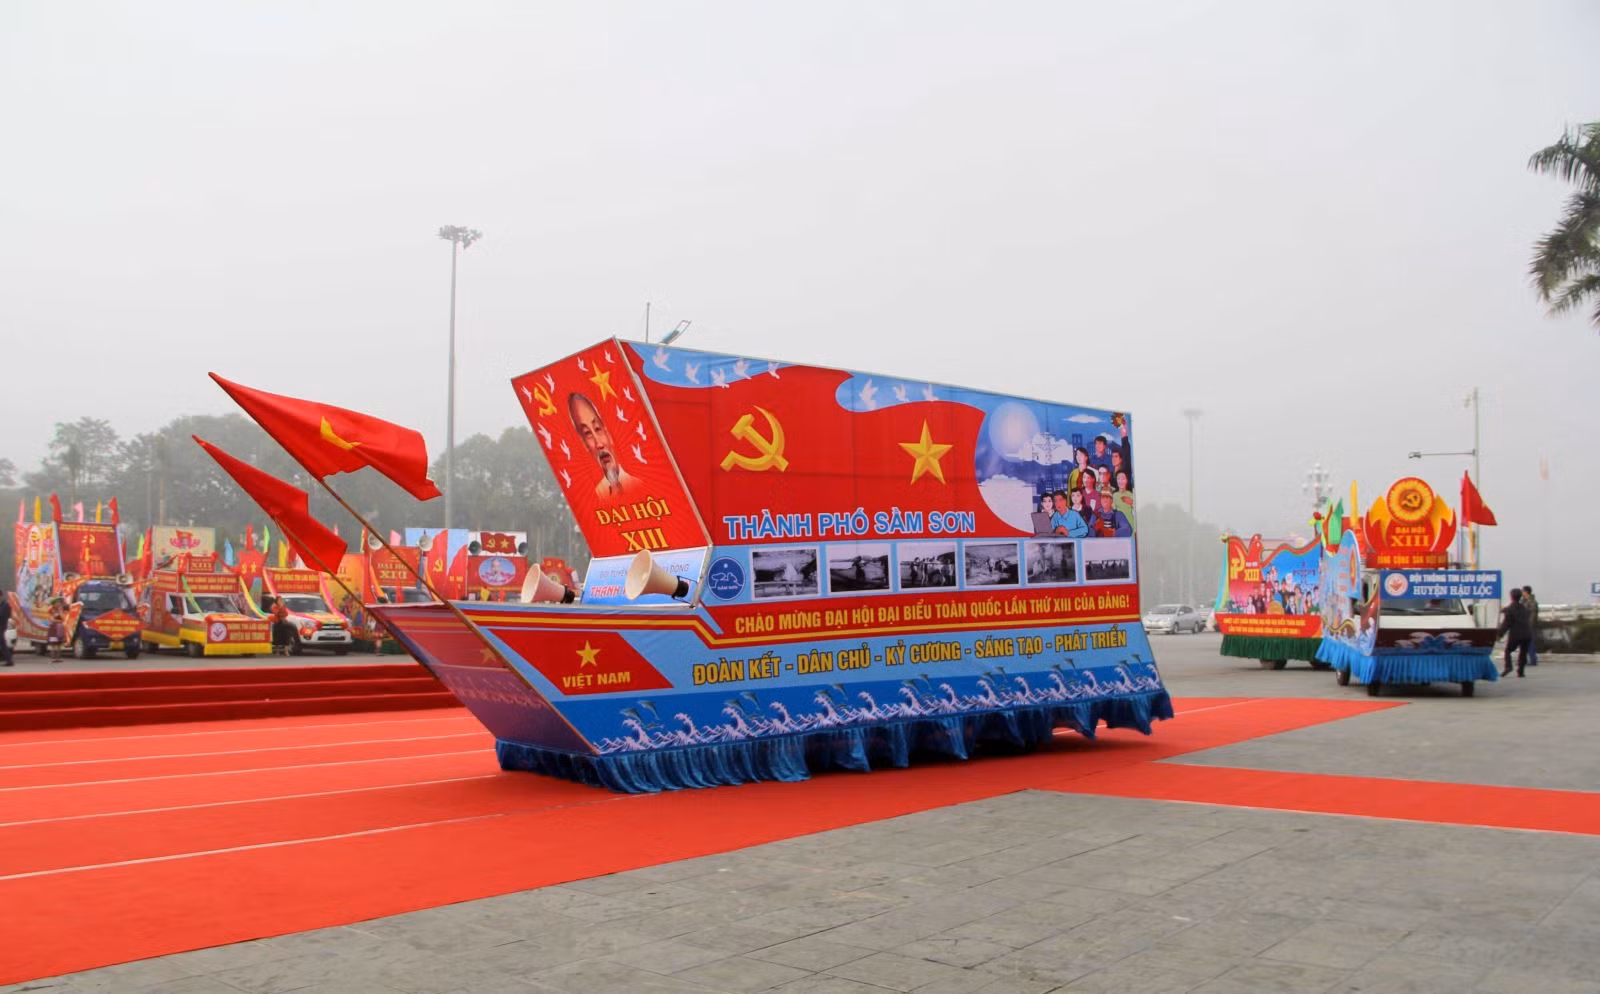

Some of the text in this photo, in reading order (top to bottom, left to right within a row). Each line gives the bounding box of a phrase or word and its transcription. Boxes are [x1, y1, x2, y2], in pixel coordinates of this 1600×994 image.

[596, 496, 672, 526] ĐẠI HỘI
[723, 506, 976, 540] THÀNH PHỐ SẦM SƠN
[621, 528, 669, 552] XIII
[1391, 535, 1429, 547] XIII
[1413, 584, 1447, 597] HUYỆN
[1472, 584, 1493, 597] LỘC
[736, 591, 1130, 634] CHÀO MỪNG ĐẠI HỘI ĐẠI BIỂU TOÀN QUỐC LẦN THỨ XIII CỦA ĐẢNG!
[692, 656, 744, 686] ĐOÀN
[748, 650, 782, 680] KẾT
[797, 648, 833, 675] DÂN
[837, 642, 871, 671] CHỦ
[885, 640, 906, 666] KỶ
[910, 640, 961, 664] CƯƠNG
[974, 635, 1014, 659] SÁNG
[1016, 635, 1043, 659] TẠO
[1055, 629, 1088, 652] PHÁT
[1090, 624, 1127, 649] TRIỂN
[562, 671, 631, 689] VIỆT NAM
